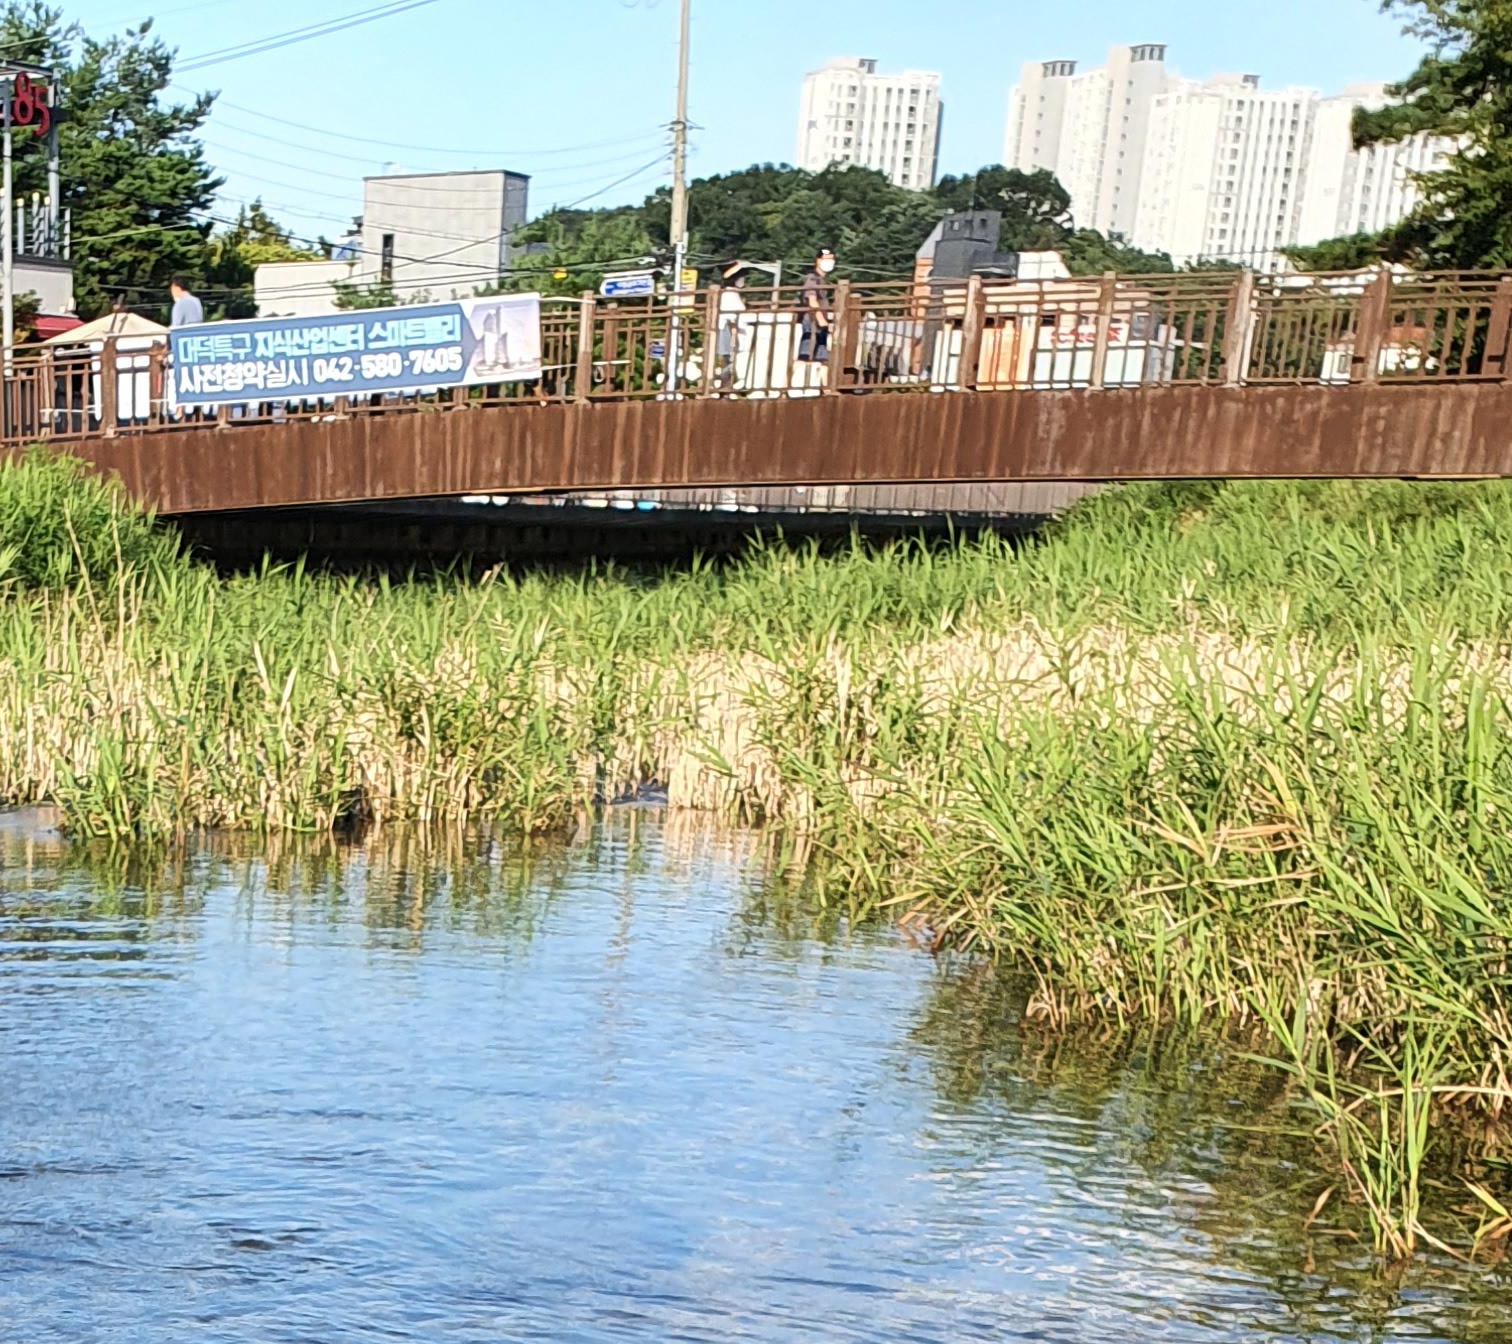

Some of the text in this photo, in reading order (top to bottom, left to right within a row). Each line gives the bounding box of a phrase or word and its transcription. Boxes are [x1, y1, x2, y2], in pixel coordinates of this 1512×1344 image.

[178, 333, 252, 363] 대덕특구
[254, 323, 365, 358] 지식산업센터
[179, 358, 309, 394] 사전청약실시
